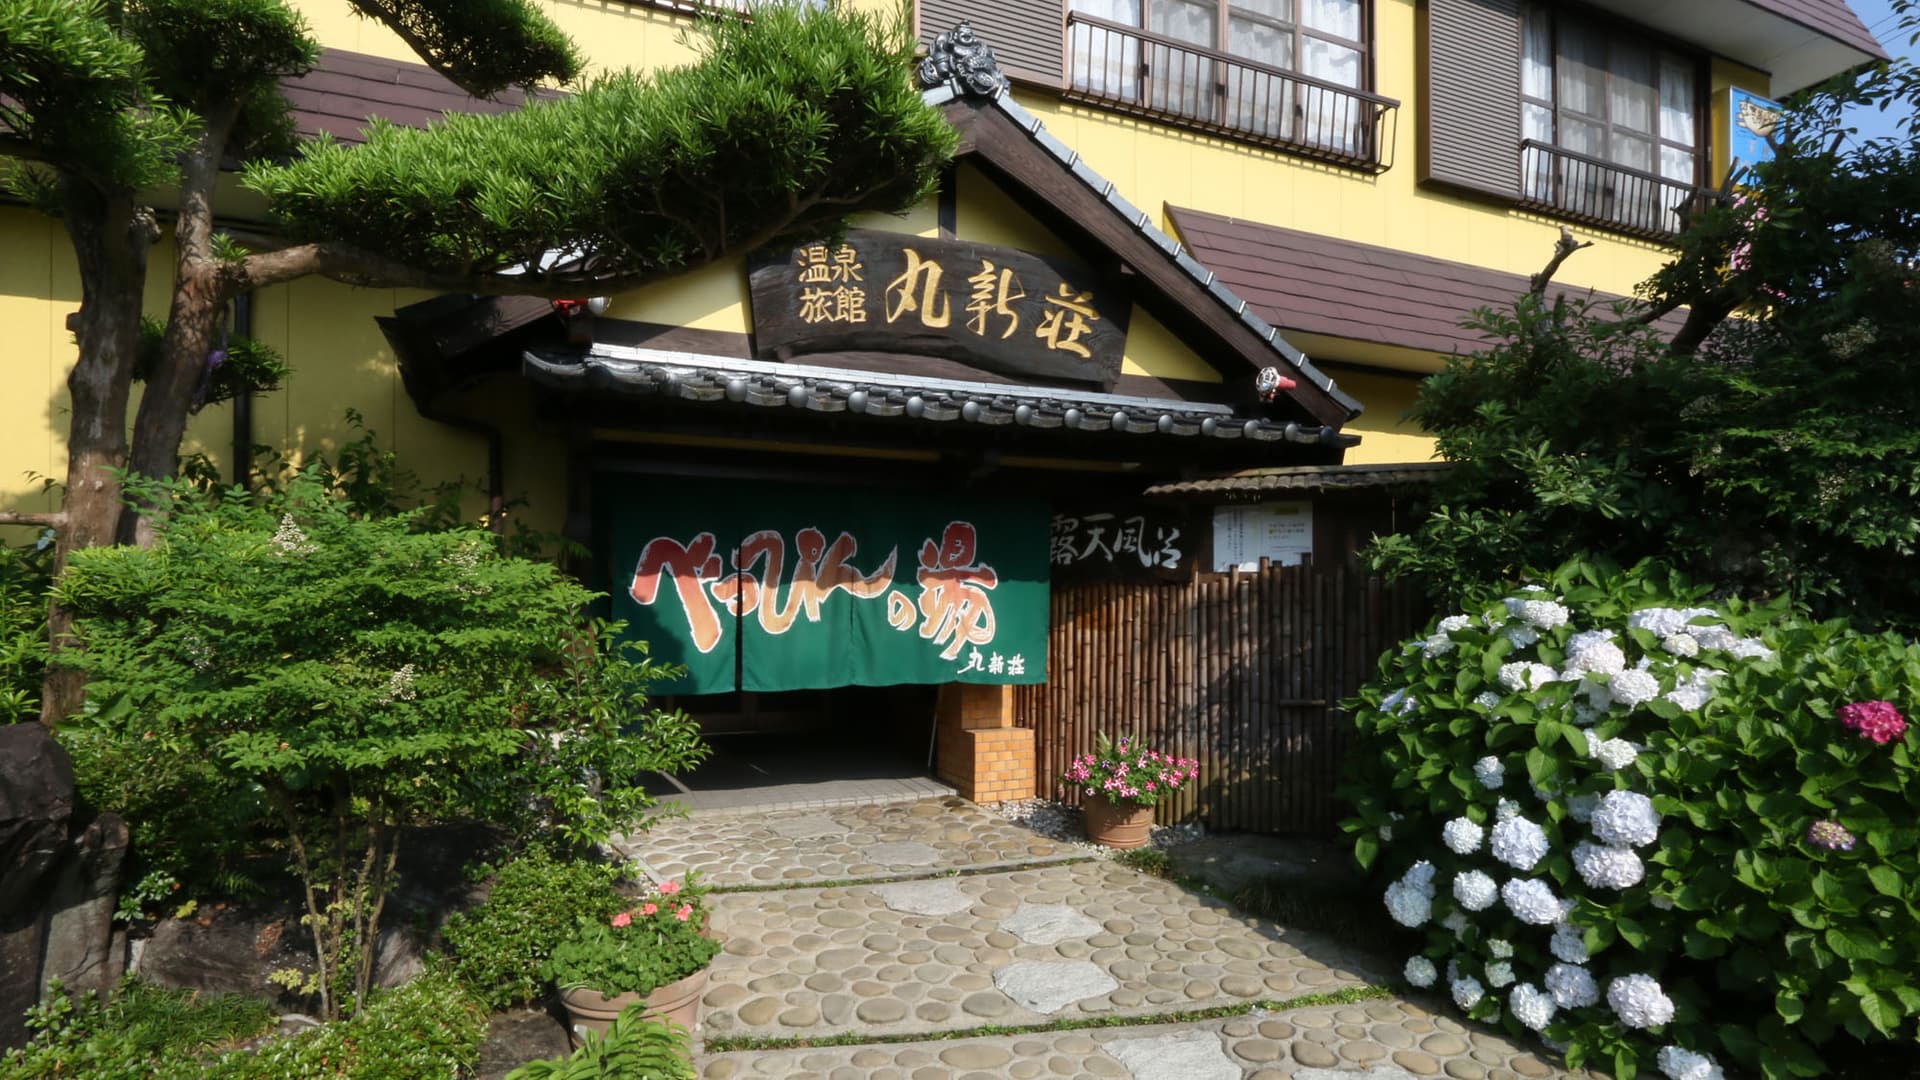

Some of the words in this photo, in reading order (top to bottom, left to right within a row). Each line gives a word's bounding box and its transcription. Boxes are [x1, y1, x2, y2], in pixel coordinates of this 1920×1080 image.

[799, 246, 863, 283] 温泉
[799, 286, 867, 325] 旅館
[885, 248, 1101, 359] 丸新荘
[957, 646, 1025, 676] 丸新荘
